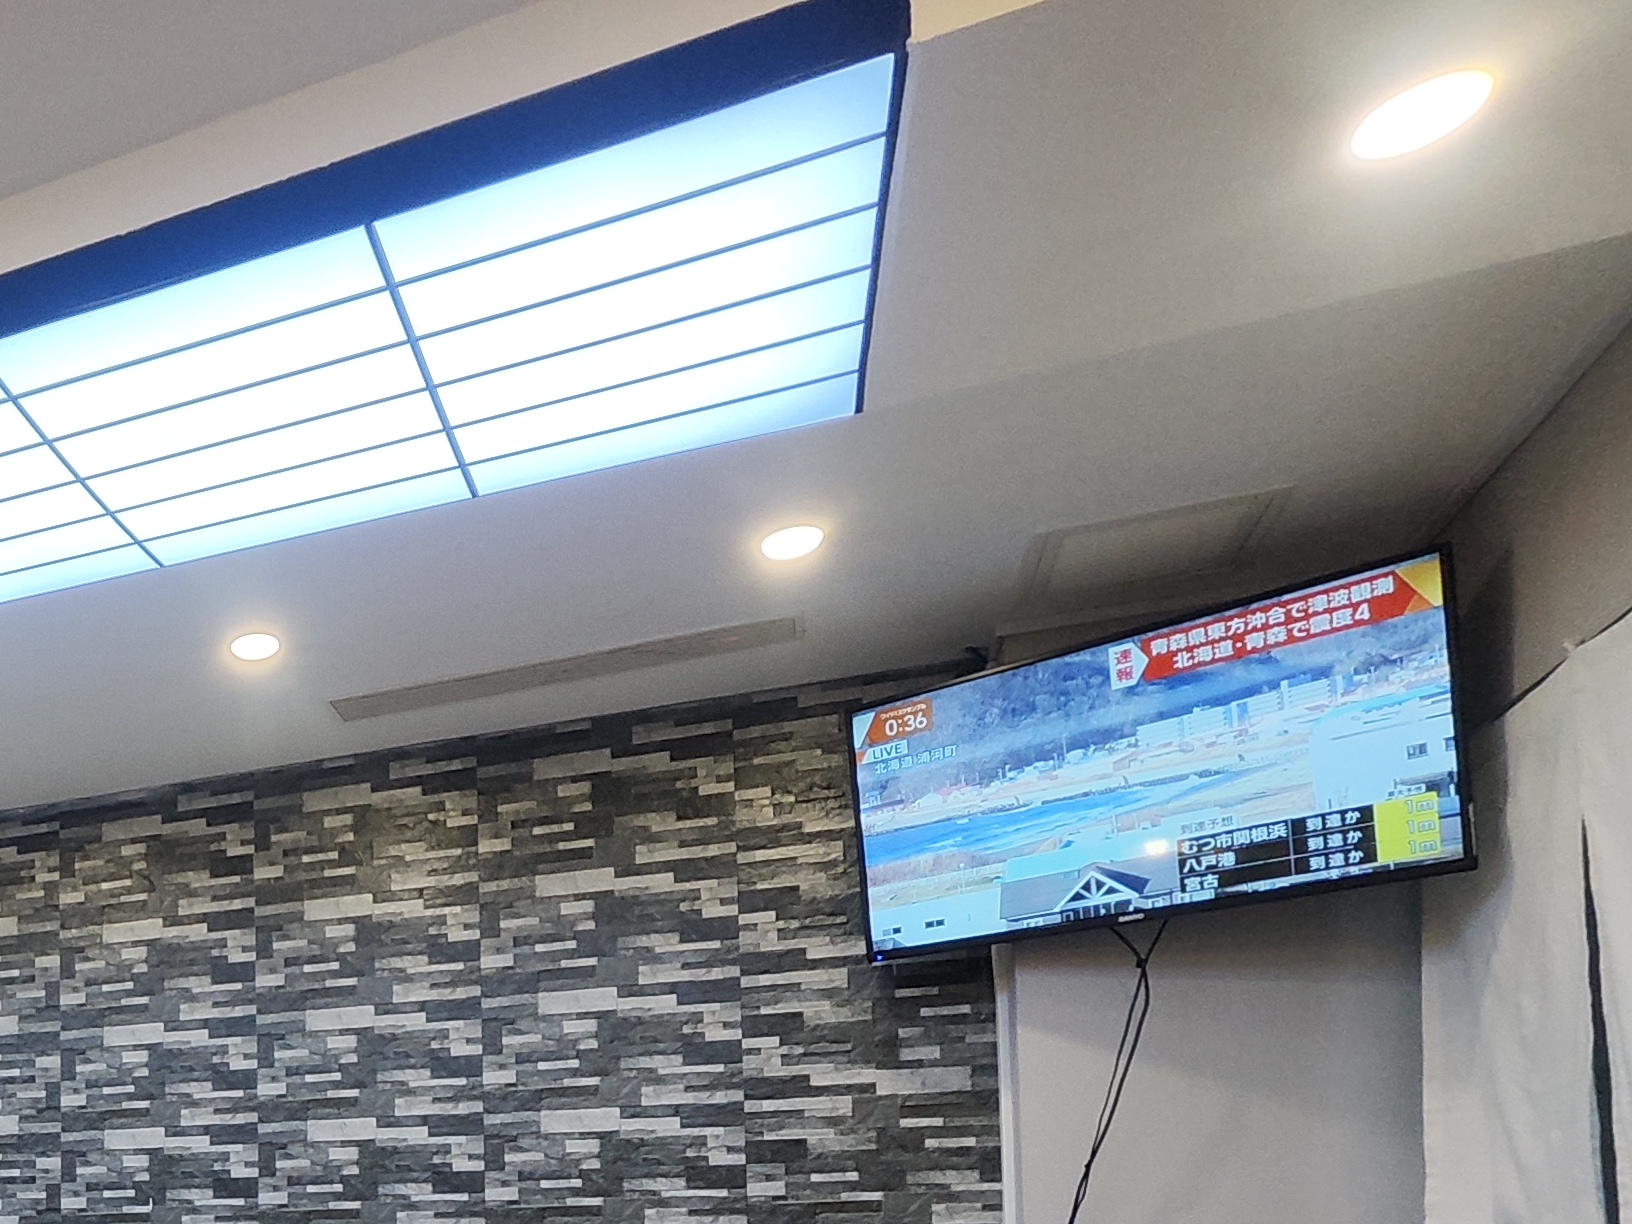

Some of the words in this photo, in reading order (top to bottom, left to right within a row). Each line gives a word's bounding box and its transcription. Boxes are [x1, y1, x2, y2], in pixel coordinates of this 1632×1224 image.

[1150, 574, 1395, 656] 青森県東方沖合で津波観測
[1114, 648, 1135, 684] 速報
[884, 711, 928, 736] 0:36
[872, 743, 903, 760] LIVE
[1180, 823, 1289, 855] むつ市関根浜
[1305, 810, 1361, 832] 到達か
[1182, 853, 1236, 874] 八戸港
[1307, 830, 1363, 852] 到達か
[1184, 874, 1219, 889] 宮古
[1308, 850, 1364, 871] 到達か
